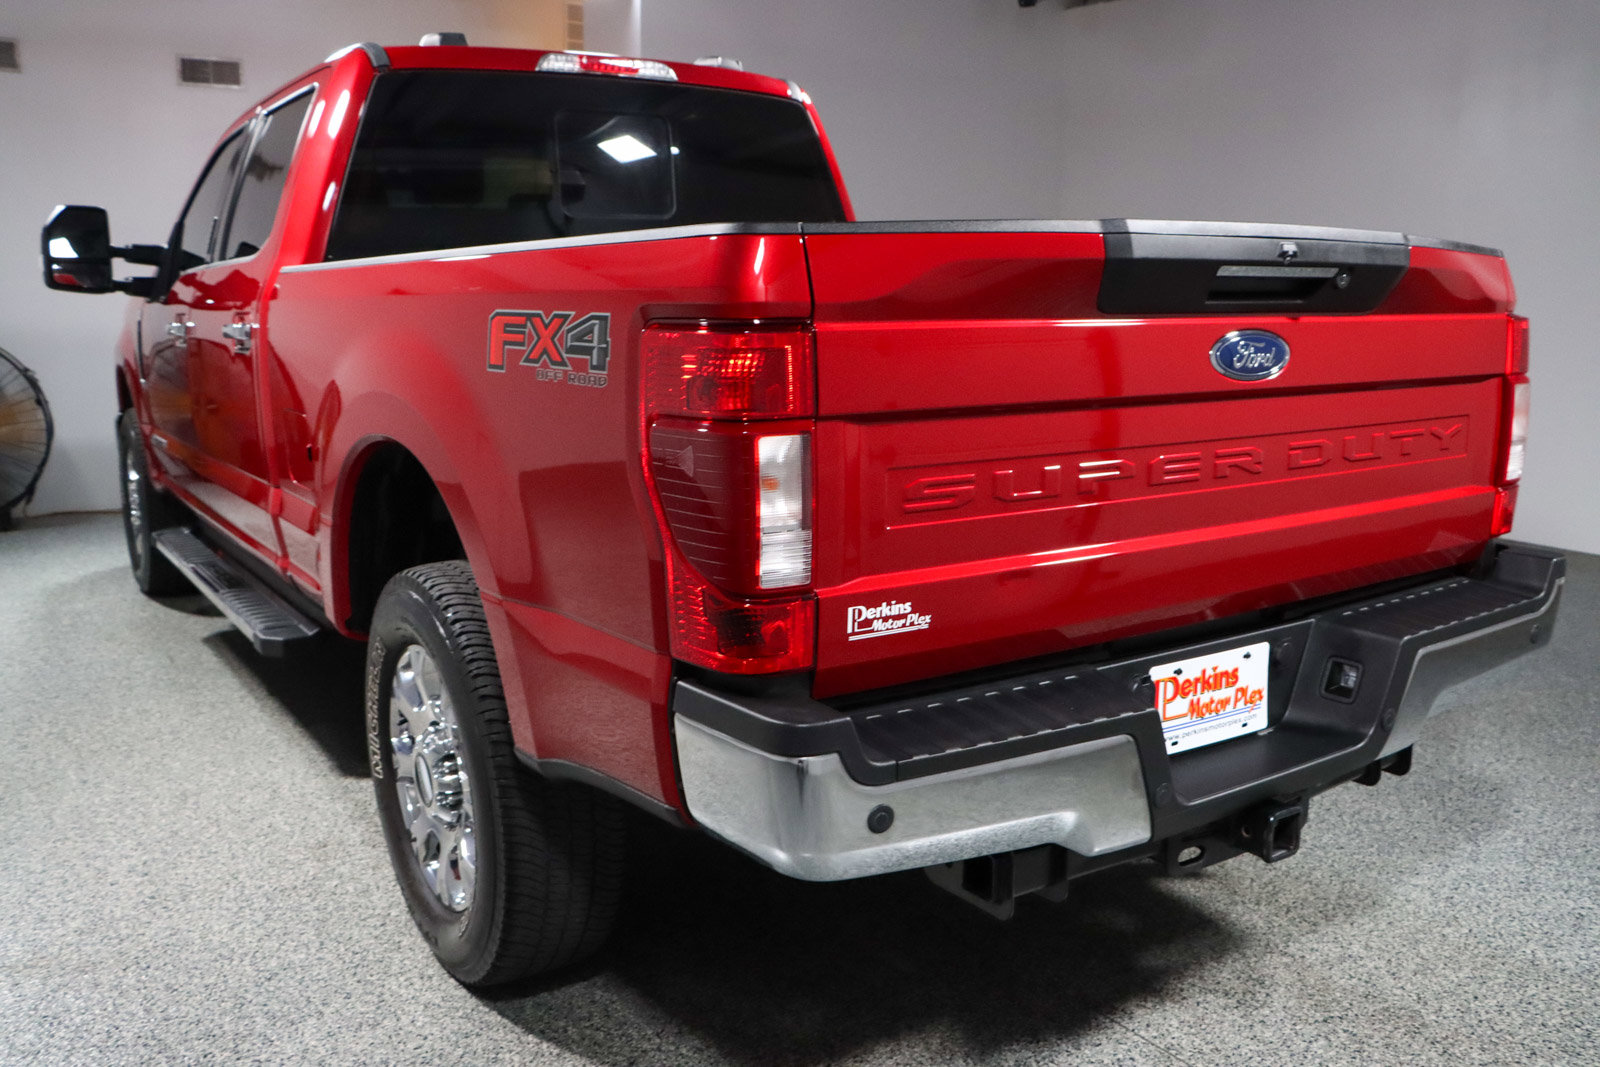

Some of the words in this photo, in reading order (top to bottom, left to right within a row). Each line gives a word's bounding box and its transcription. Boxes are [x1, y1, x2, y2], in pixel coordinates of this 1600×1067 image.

[487, 309, 611, 373] FX4
[1233, 340, 1276, 369] Ford
[535, 368, 563, 382] OFF
[567, 371, 608, 388] ROAD
[904, 446, 1261, 514] SUPER
[1287, 424, 1462, 470] DUTY
[847, 600, 912, 634] Perkins
[872, 616, 905, 631] Motor
[905, 613, 932, 628] Plex
[1154, 666, 1239, 721] Perkins
[1188, 696, 1231, 720] Motor
[1233, 685, 1264, 713] Plex
